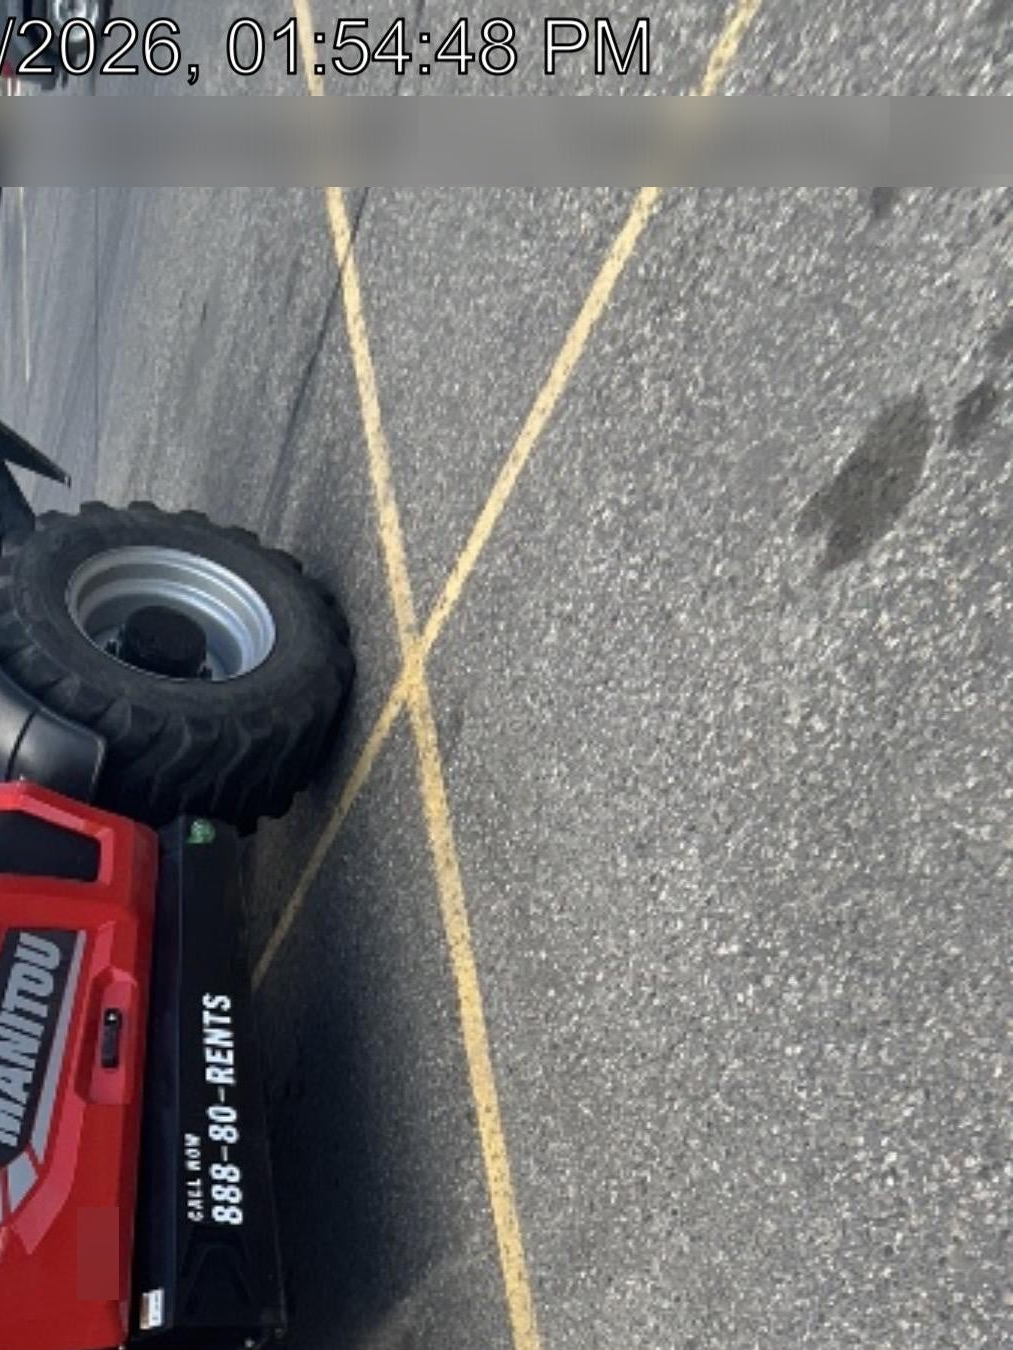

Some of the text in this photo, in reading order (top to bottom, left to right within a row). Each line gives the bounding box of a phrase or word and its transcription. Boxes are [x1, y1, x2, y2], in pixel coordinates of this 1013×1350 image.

[184, 1133, 204, 1222] CALL NOW
[202, 992, 243, 1225] 888-80-RENTS
